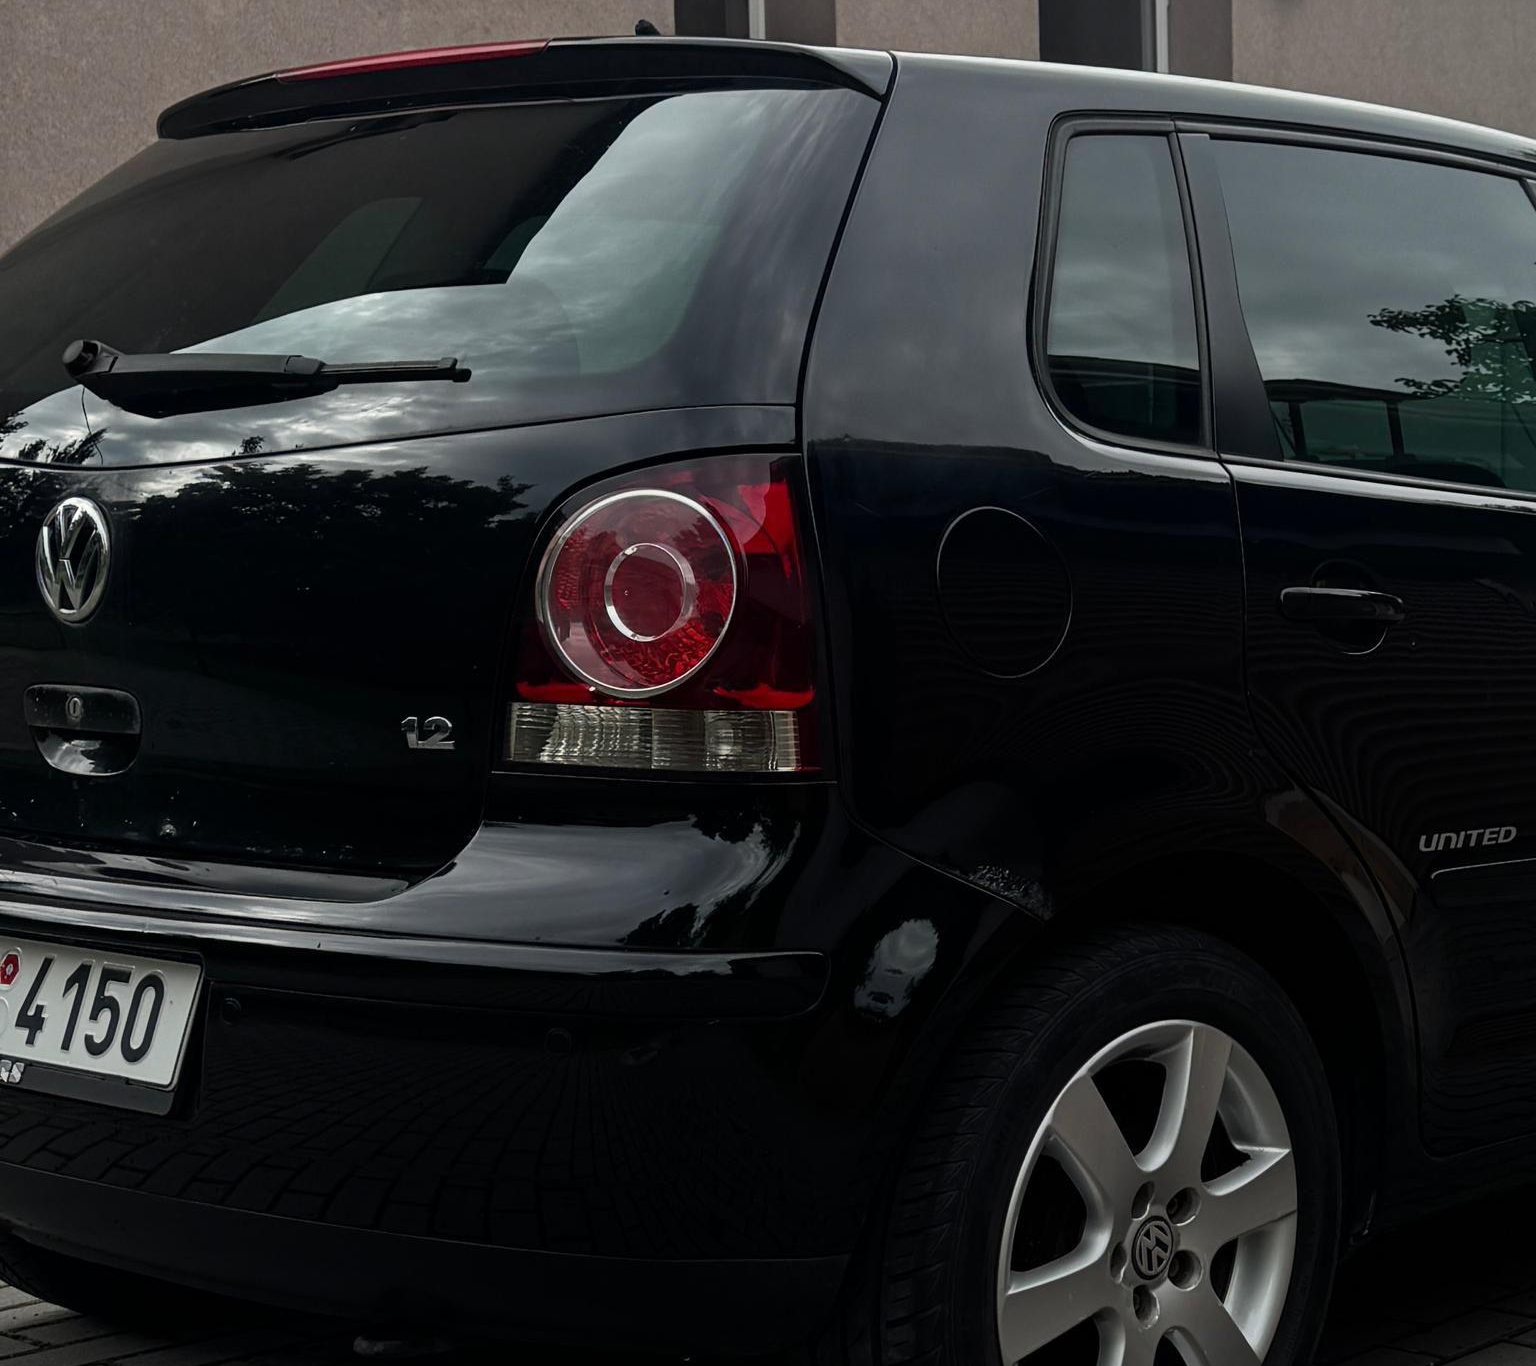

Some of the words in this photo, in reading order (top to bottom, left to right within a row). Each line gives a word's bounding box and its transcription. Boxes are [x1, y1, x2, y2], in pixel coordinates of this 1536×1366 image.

[36, 496, 111, 624] VW
[1418, 826, 1518, 852] UNITED
[15, 956, 165, 1064] 4150
